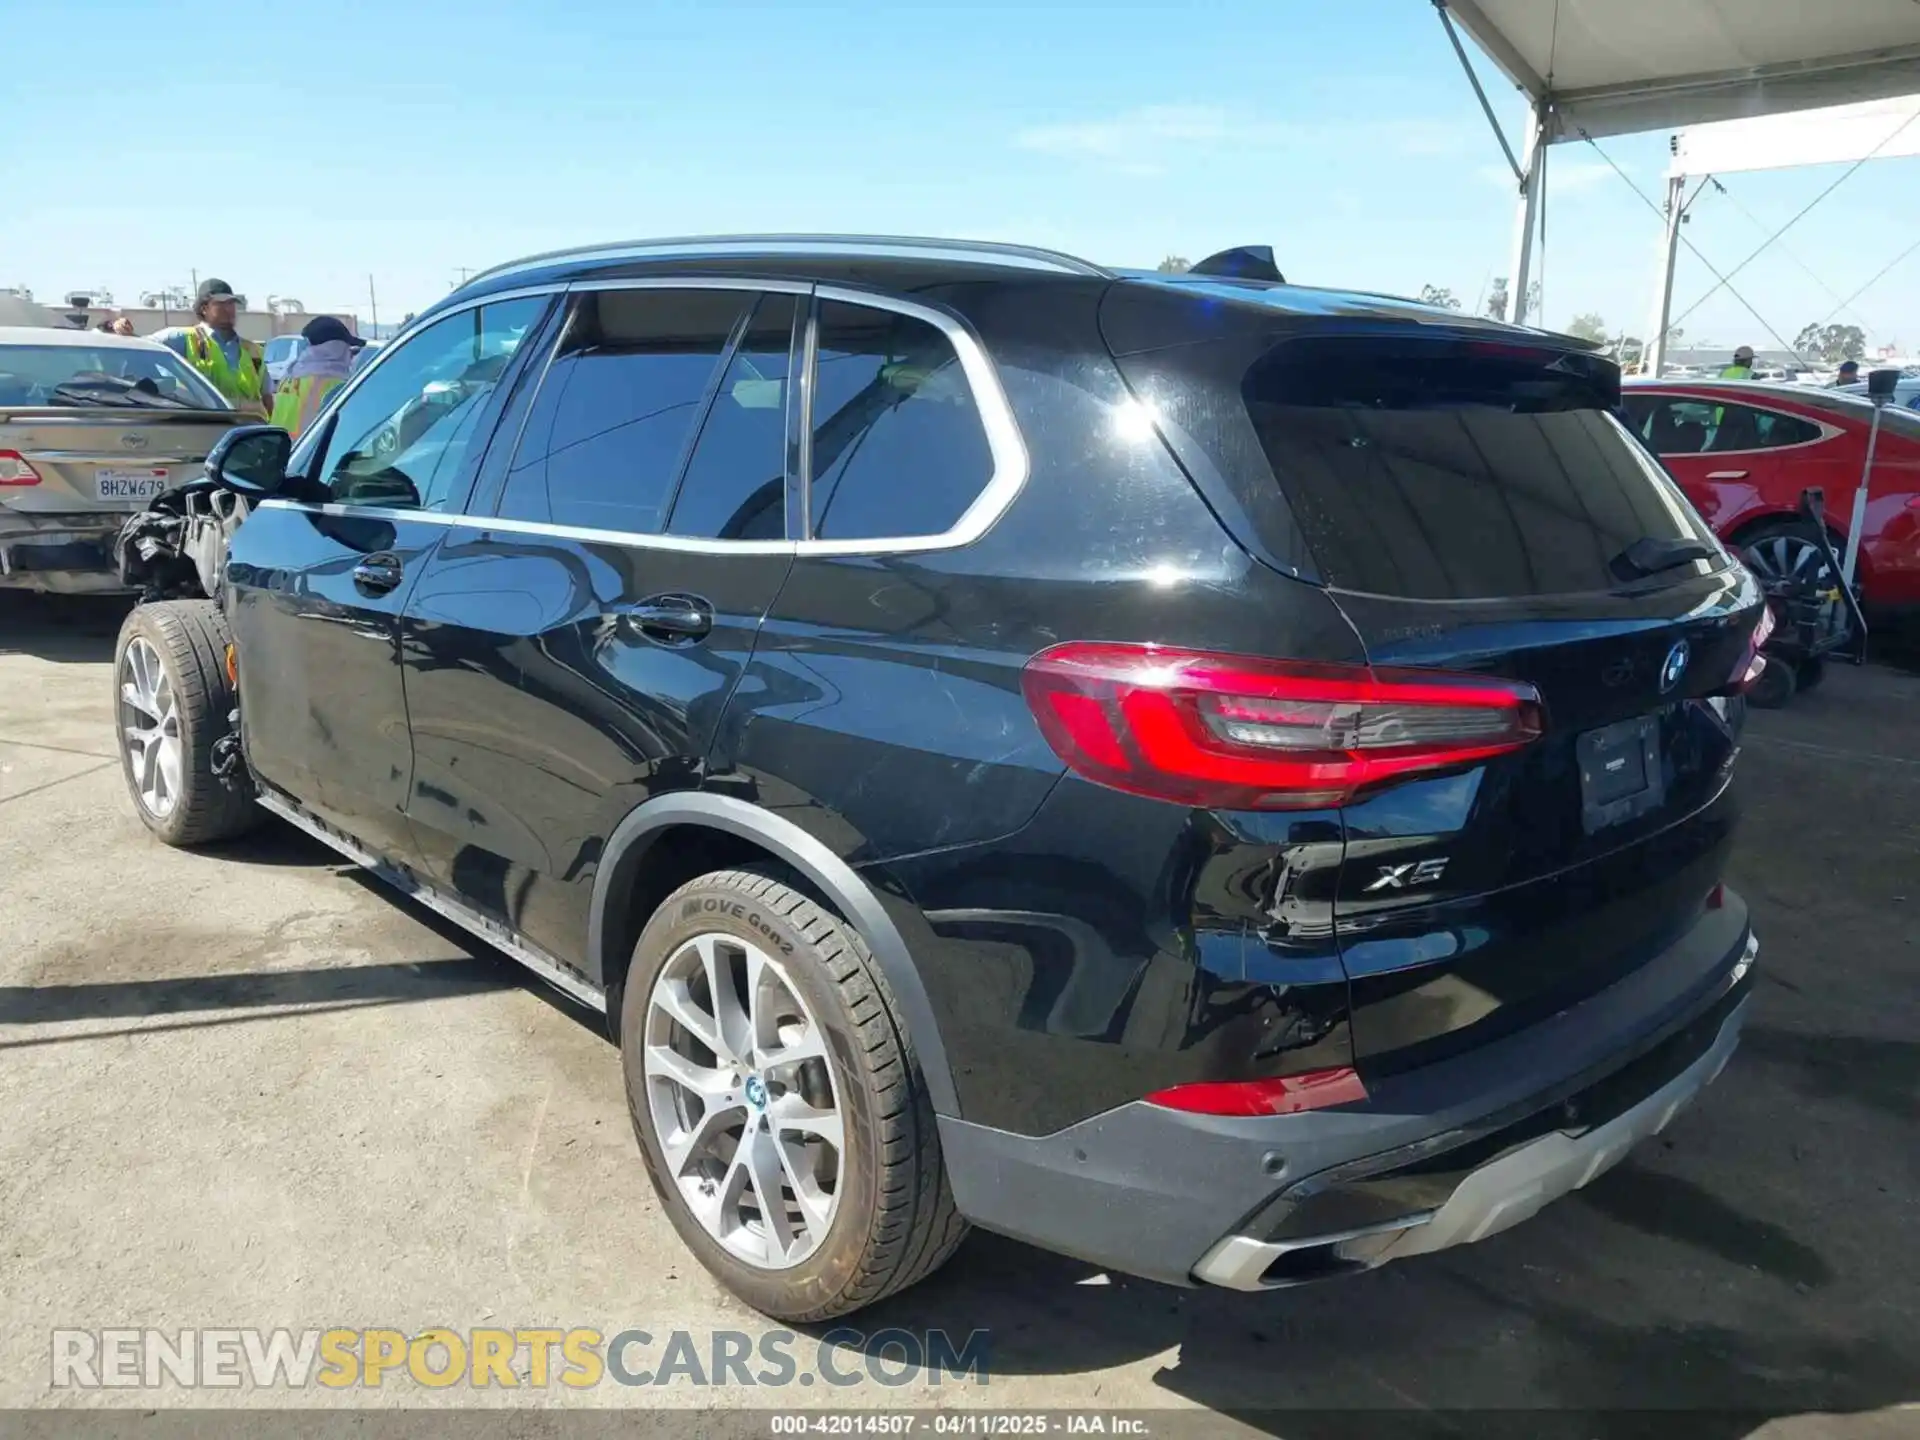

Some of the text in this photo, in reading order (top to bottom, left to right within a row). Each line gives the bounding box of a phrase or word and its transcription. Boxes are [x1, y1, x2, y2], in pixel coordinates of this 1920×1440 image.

[100, 480, 165, 496] 8HZW679
[1362, 857, 1450, 892] X5
[748, 913, 795, 956] Gen2
